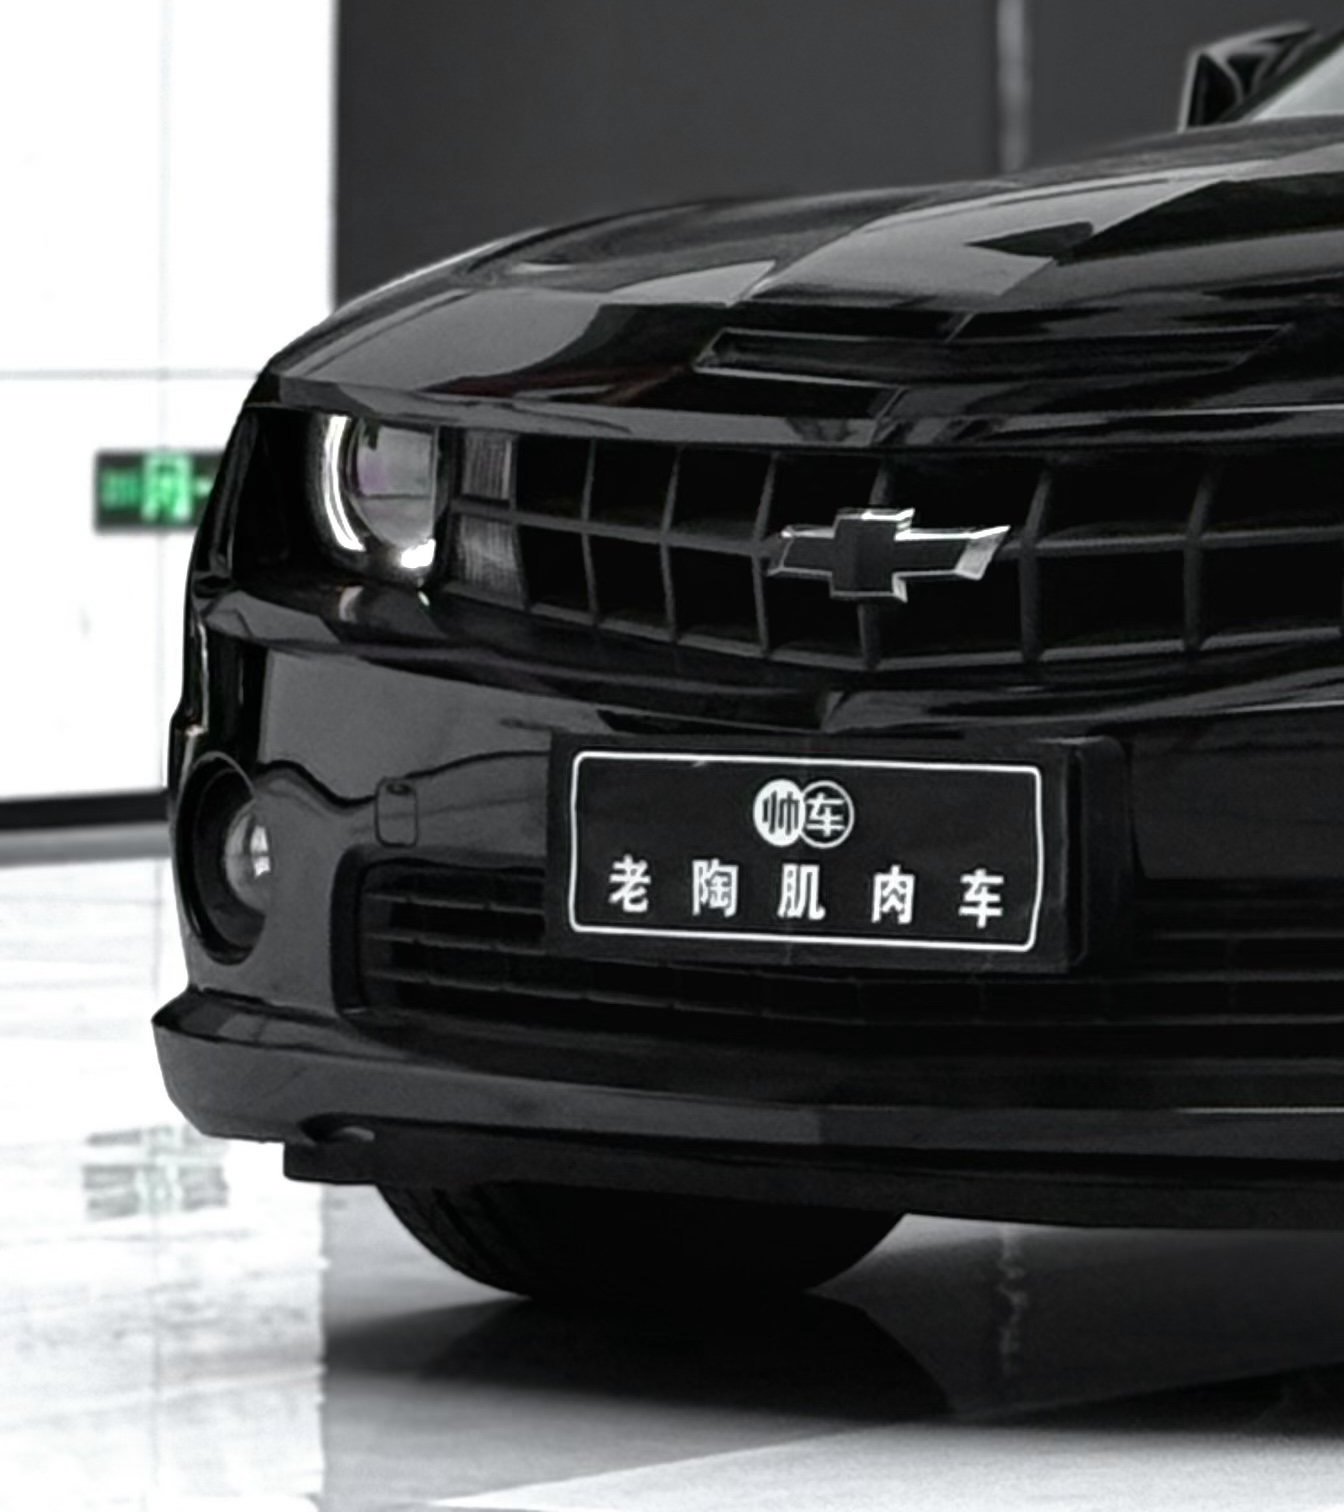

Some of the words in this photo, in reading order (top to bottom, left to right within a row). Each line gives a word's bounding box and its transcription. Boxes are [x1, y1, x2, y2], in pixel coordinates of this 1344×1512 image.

[760, 788, 847, 840] 帅车
[608, 853, 1005, 929] 老陶肌肉车
